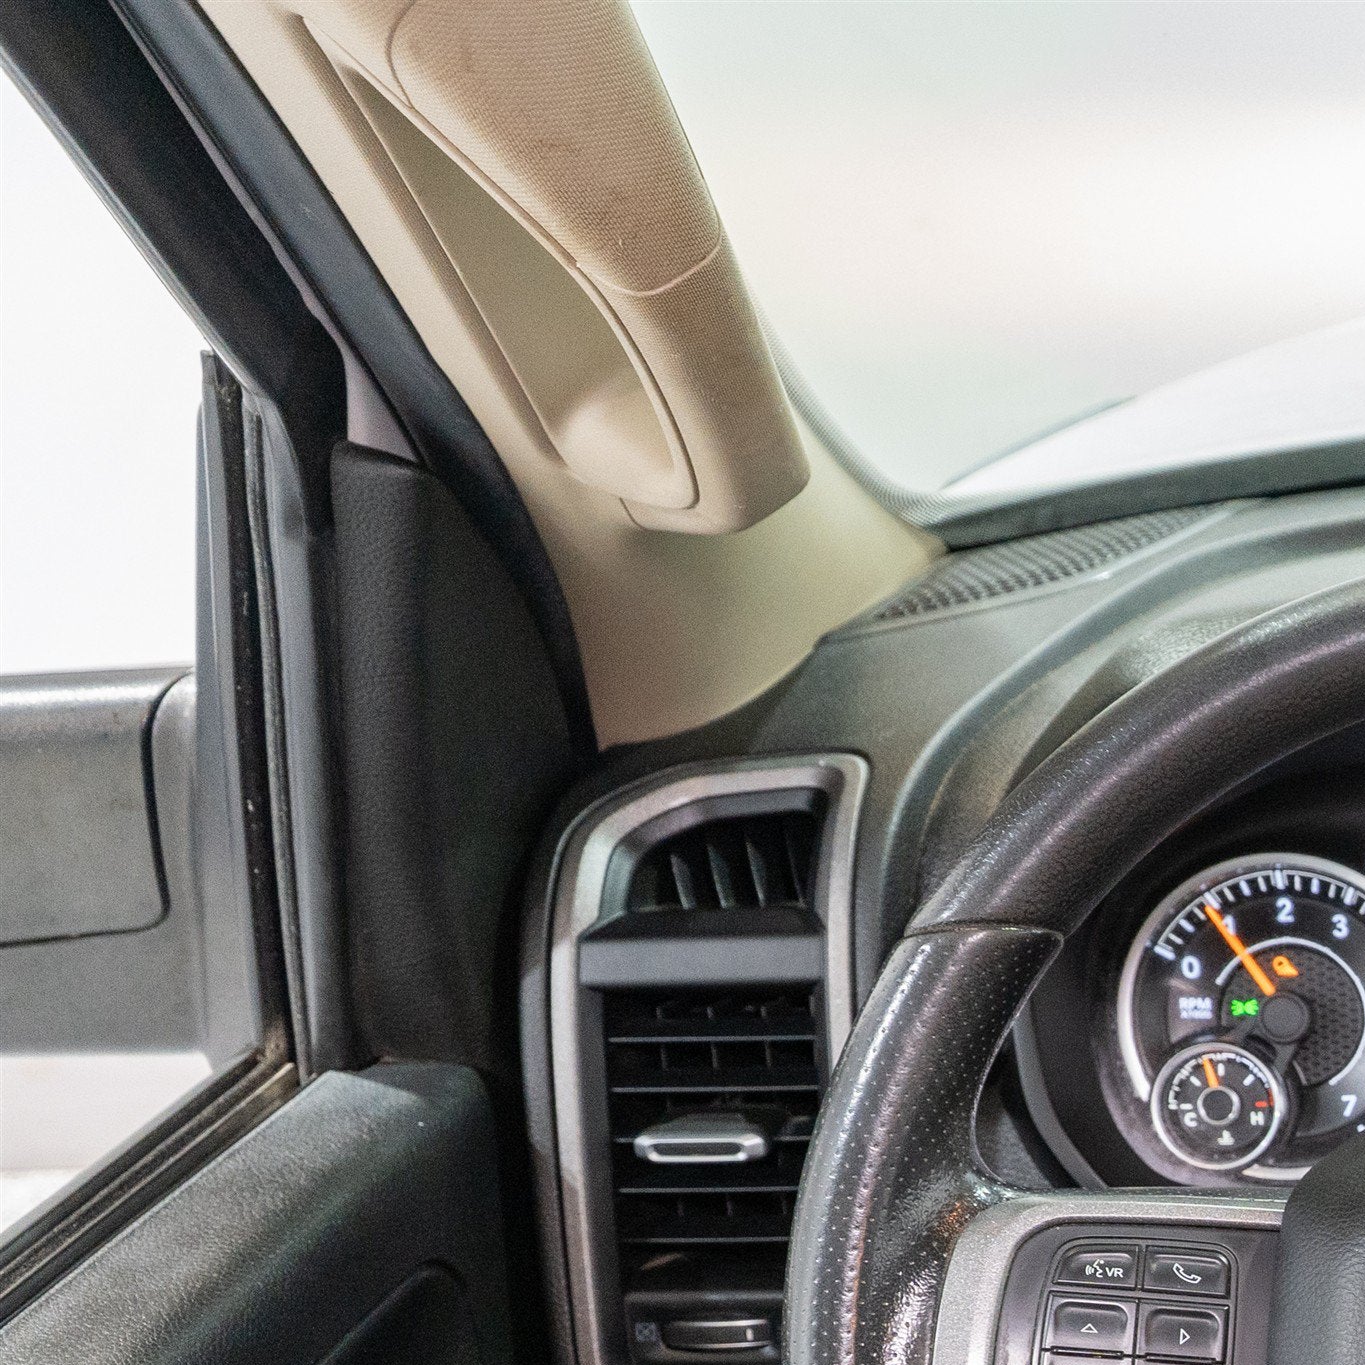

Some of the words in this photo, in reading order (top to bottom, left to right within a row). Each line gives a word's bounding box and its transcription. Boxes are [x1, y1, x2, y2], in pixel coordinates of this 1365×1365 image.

[1276, 897, 1295, 924] 2
[1332, 914, 1350, 940] 3
[1181, 955, 1199, 979] 0
[1340, 1094, 1358, 1117] 7
[1184, 1111, 1198, 1128] C
[1250, 1111, 1264, 1126] H
[1106, 1266, 1124, 1279] VR
